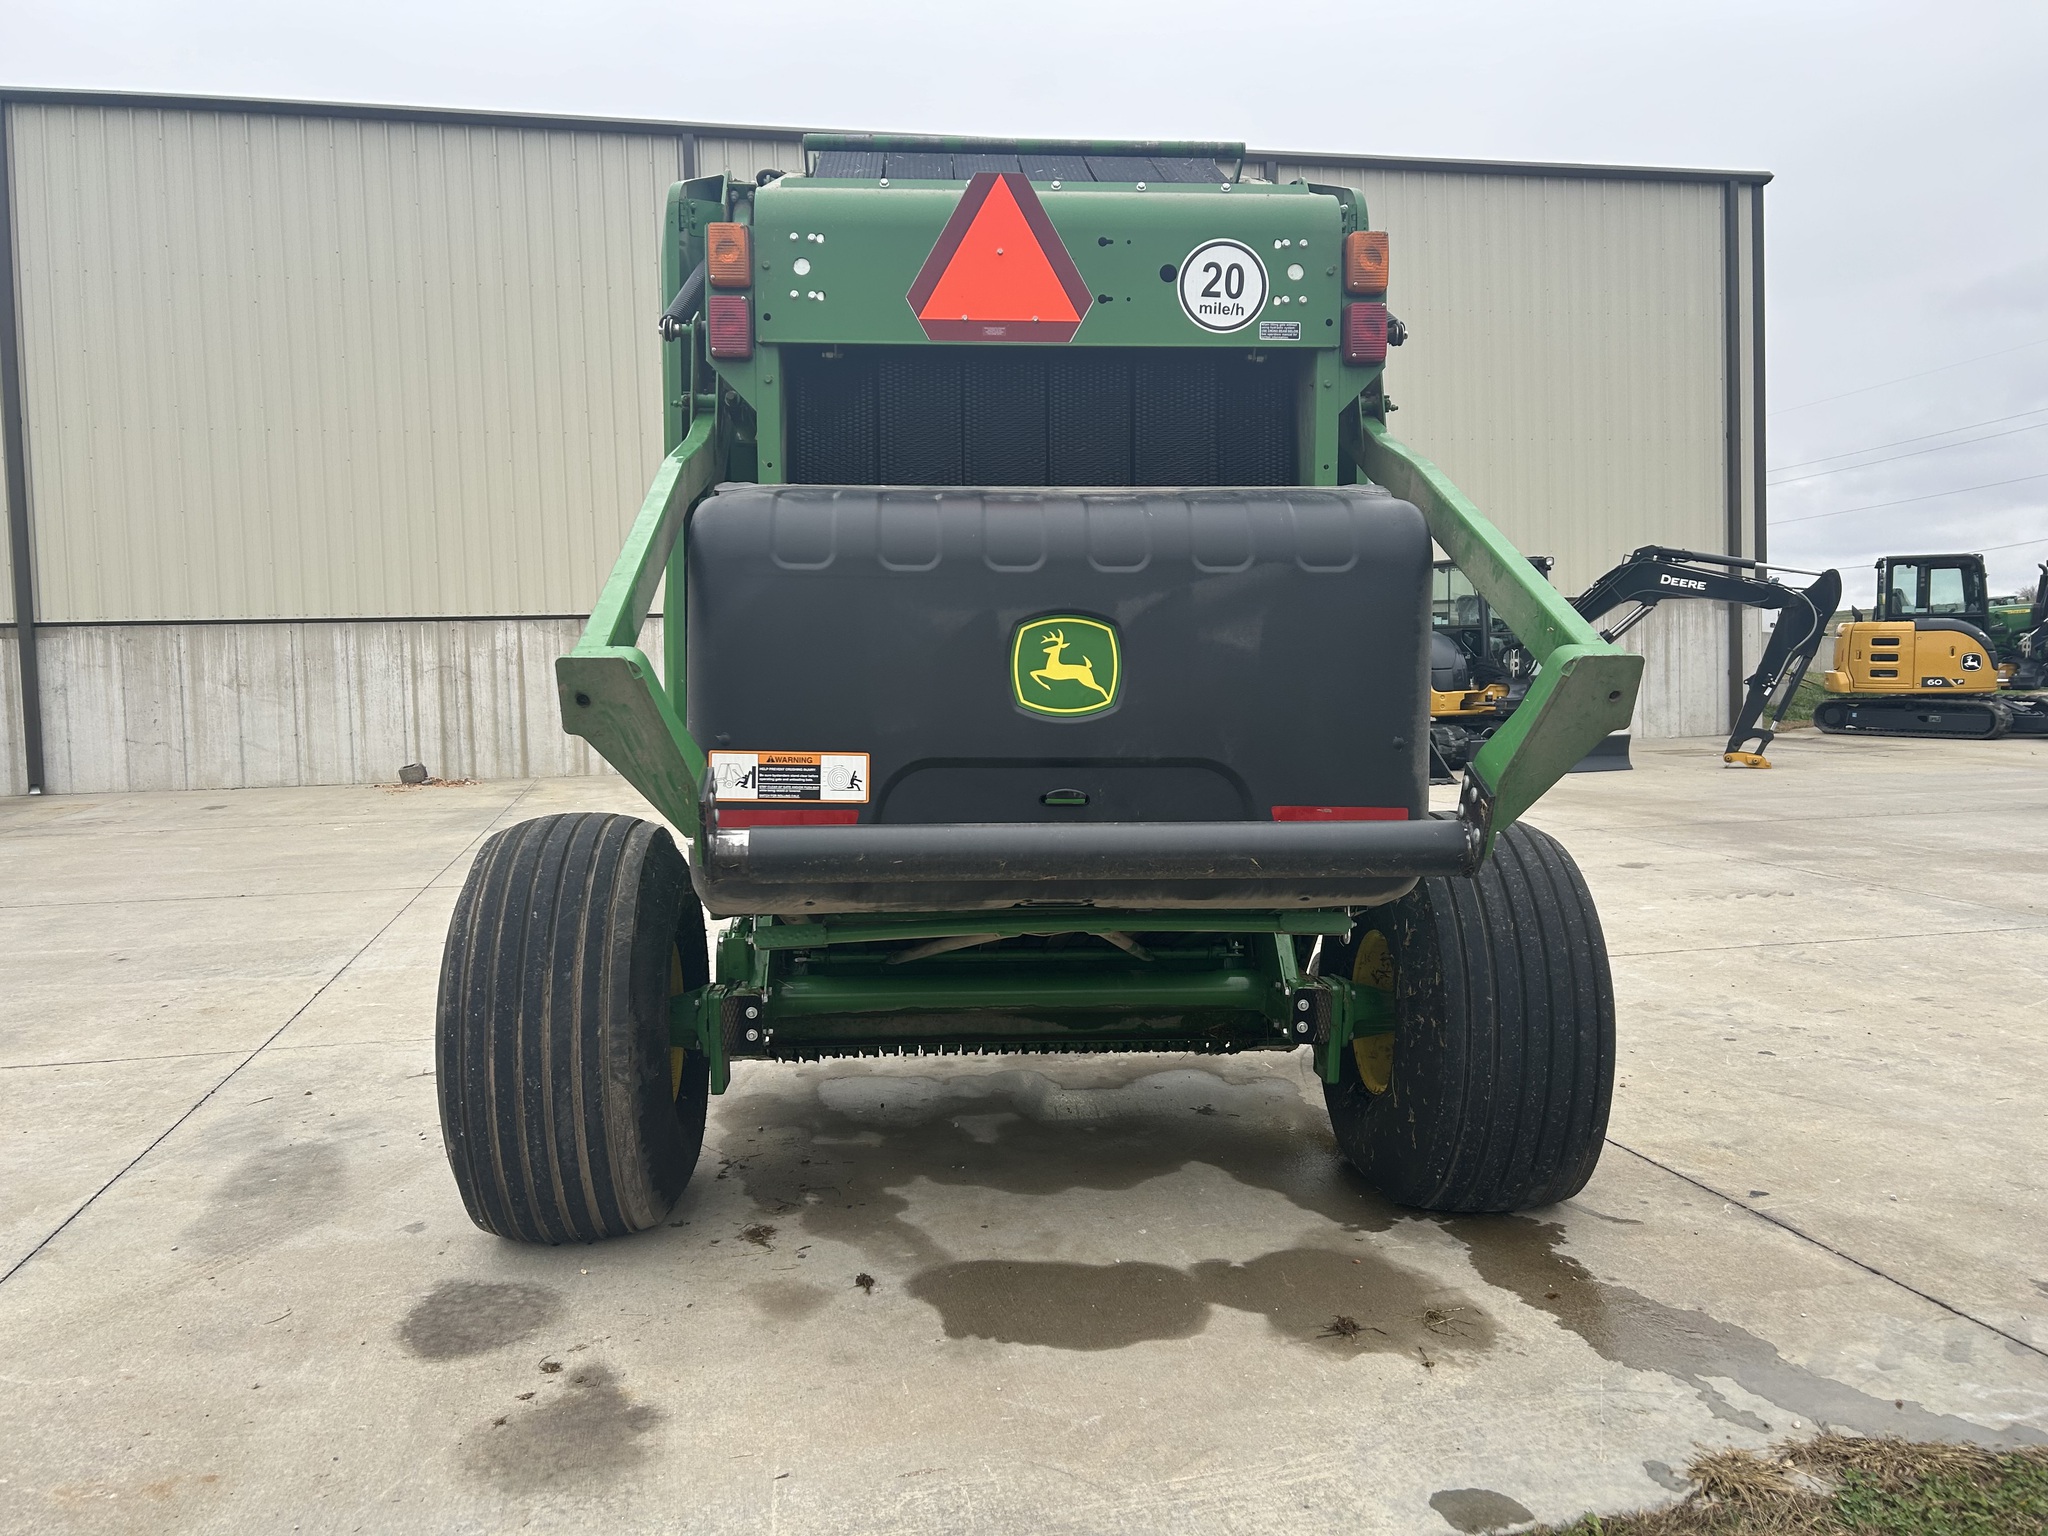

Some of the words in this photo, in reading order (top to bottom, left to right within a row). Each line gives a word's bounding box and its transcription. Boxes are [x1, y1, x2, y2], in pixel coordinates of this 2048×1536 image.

[1201, 261, 1245, 299] 20
[1199, 302, 1245, 317] mile/h
[1660, 574, 1707, 590] DEERE
[775, 756, 813, 764] WARNING
